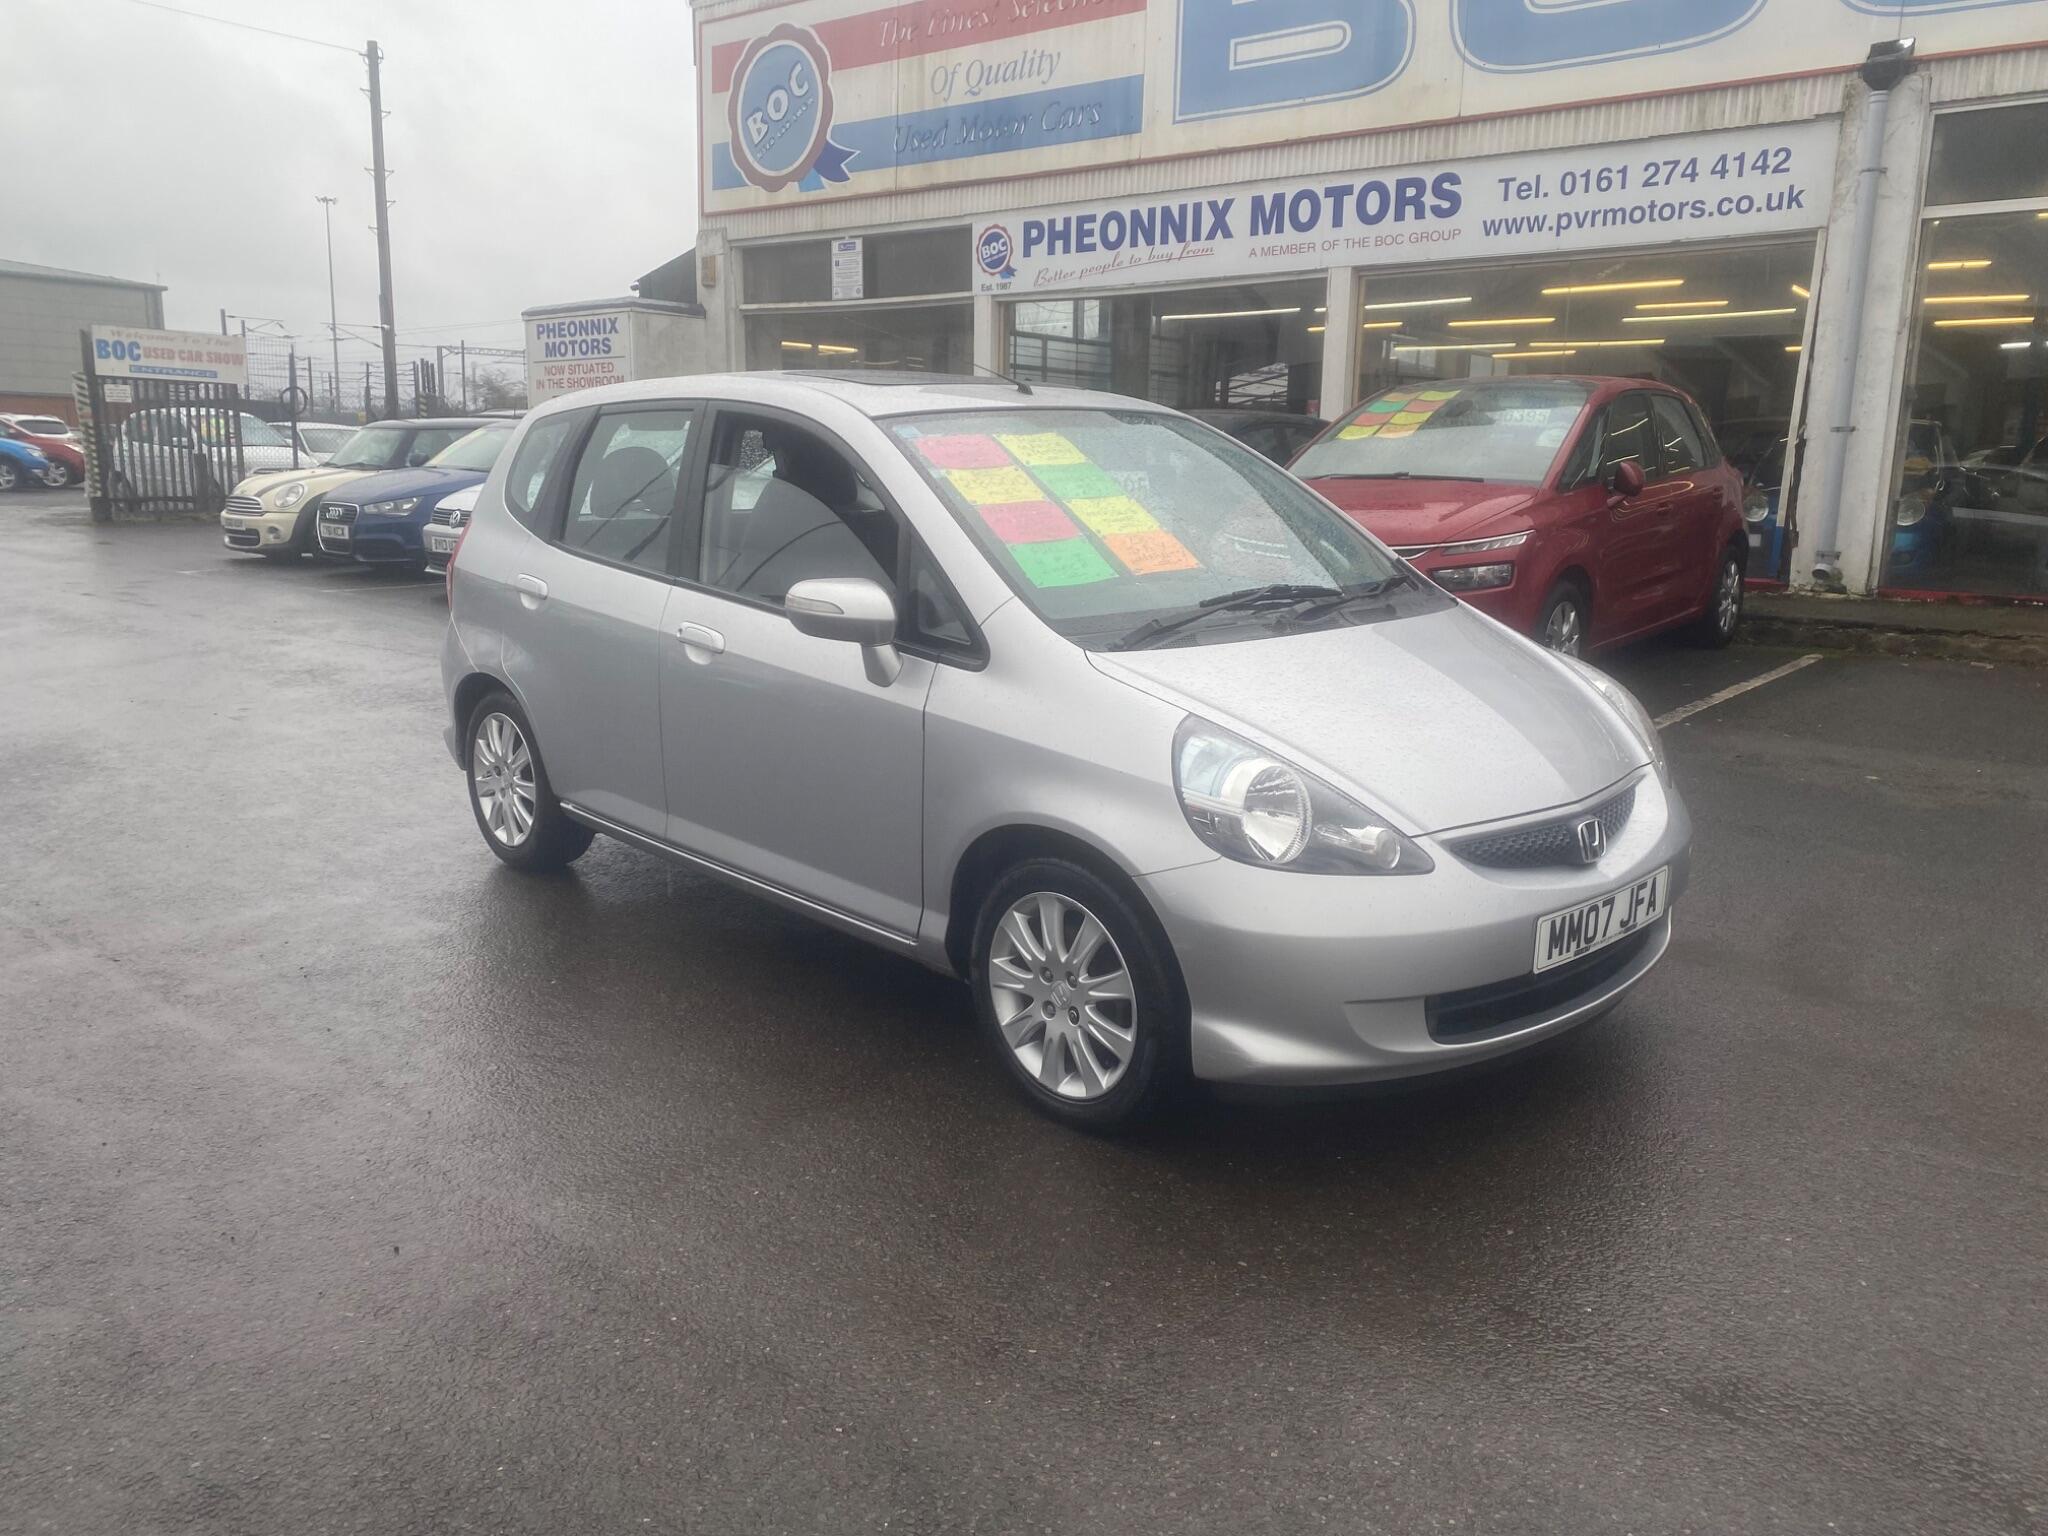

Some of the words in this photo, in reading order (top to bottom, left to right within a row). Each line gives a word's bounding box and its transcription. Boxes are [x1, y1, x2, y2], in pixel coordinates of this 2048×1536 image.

[930, 64, 959, 101] Of
[965, 49, 1061, 96] Quality
[746, 62, 810, 146] BOC
[893, 119, 948, 153] Used
[954, 113, 1031, 145] Motor
[1041, 101, 1103, 132] Cars
[1498, 173, 1549, 202] Tel.
[1560, 165, 1629, 196] 0161
[1642, 156, 1699, 189] 274
[1710, 146, 1792, 180] 4142
[1022, 198, 1236, 258] PHEONNIX
[1249, 171, 1462, 237] MOTORS
[1482, 184, 1806, 237] www.pvrmotors.co.uk
[981, 239, 1007, 259] BOC
[1248, 247, 1258, 258] A
[1260, 242, 1316, 257] MEMBER
[1321, 239, 1340, 252] OF
[1344, 236, 1370, 250] THE
[1374, 233, 1404, 248] BOC
[1408, 228, 1462, 244] GROUP
[1034, 267, 1076, 287] Better
[1079, 251, 1125, 280] people
[1128, 253, 1142, 265] to
[1148, 246, 1173, 263] buy
[1178, 240, 1216, 260] from
[536, 317, 619, 340] PHEONNIX
[544, 337, 612, 358] MOTORS
[95, 338, 142, 362] BOC
[143, 346, 176, 361] USED
[178, 350, 203, 363] CAR
[206, 351, 244, 366] SHOW
[544, 366, 566, 376] NOW
[568, 362, 615, 375] SITUATED
[131, 366, 217, 378] ENTRANCE
[535, 379, 545, 390] IN
[547, 378, 565, 389] THE
[567, 375, 625, 389] SHOWROOM
[1547, 896, 1616, 961] MM07
[1620, 877, 1657, 928] JFA
